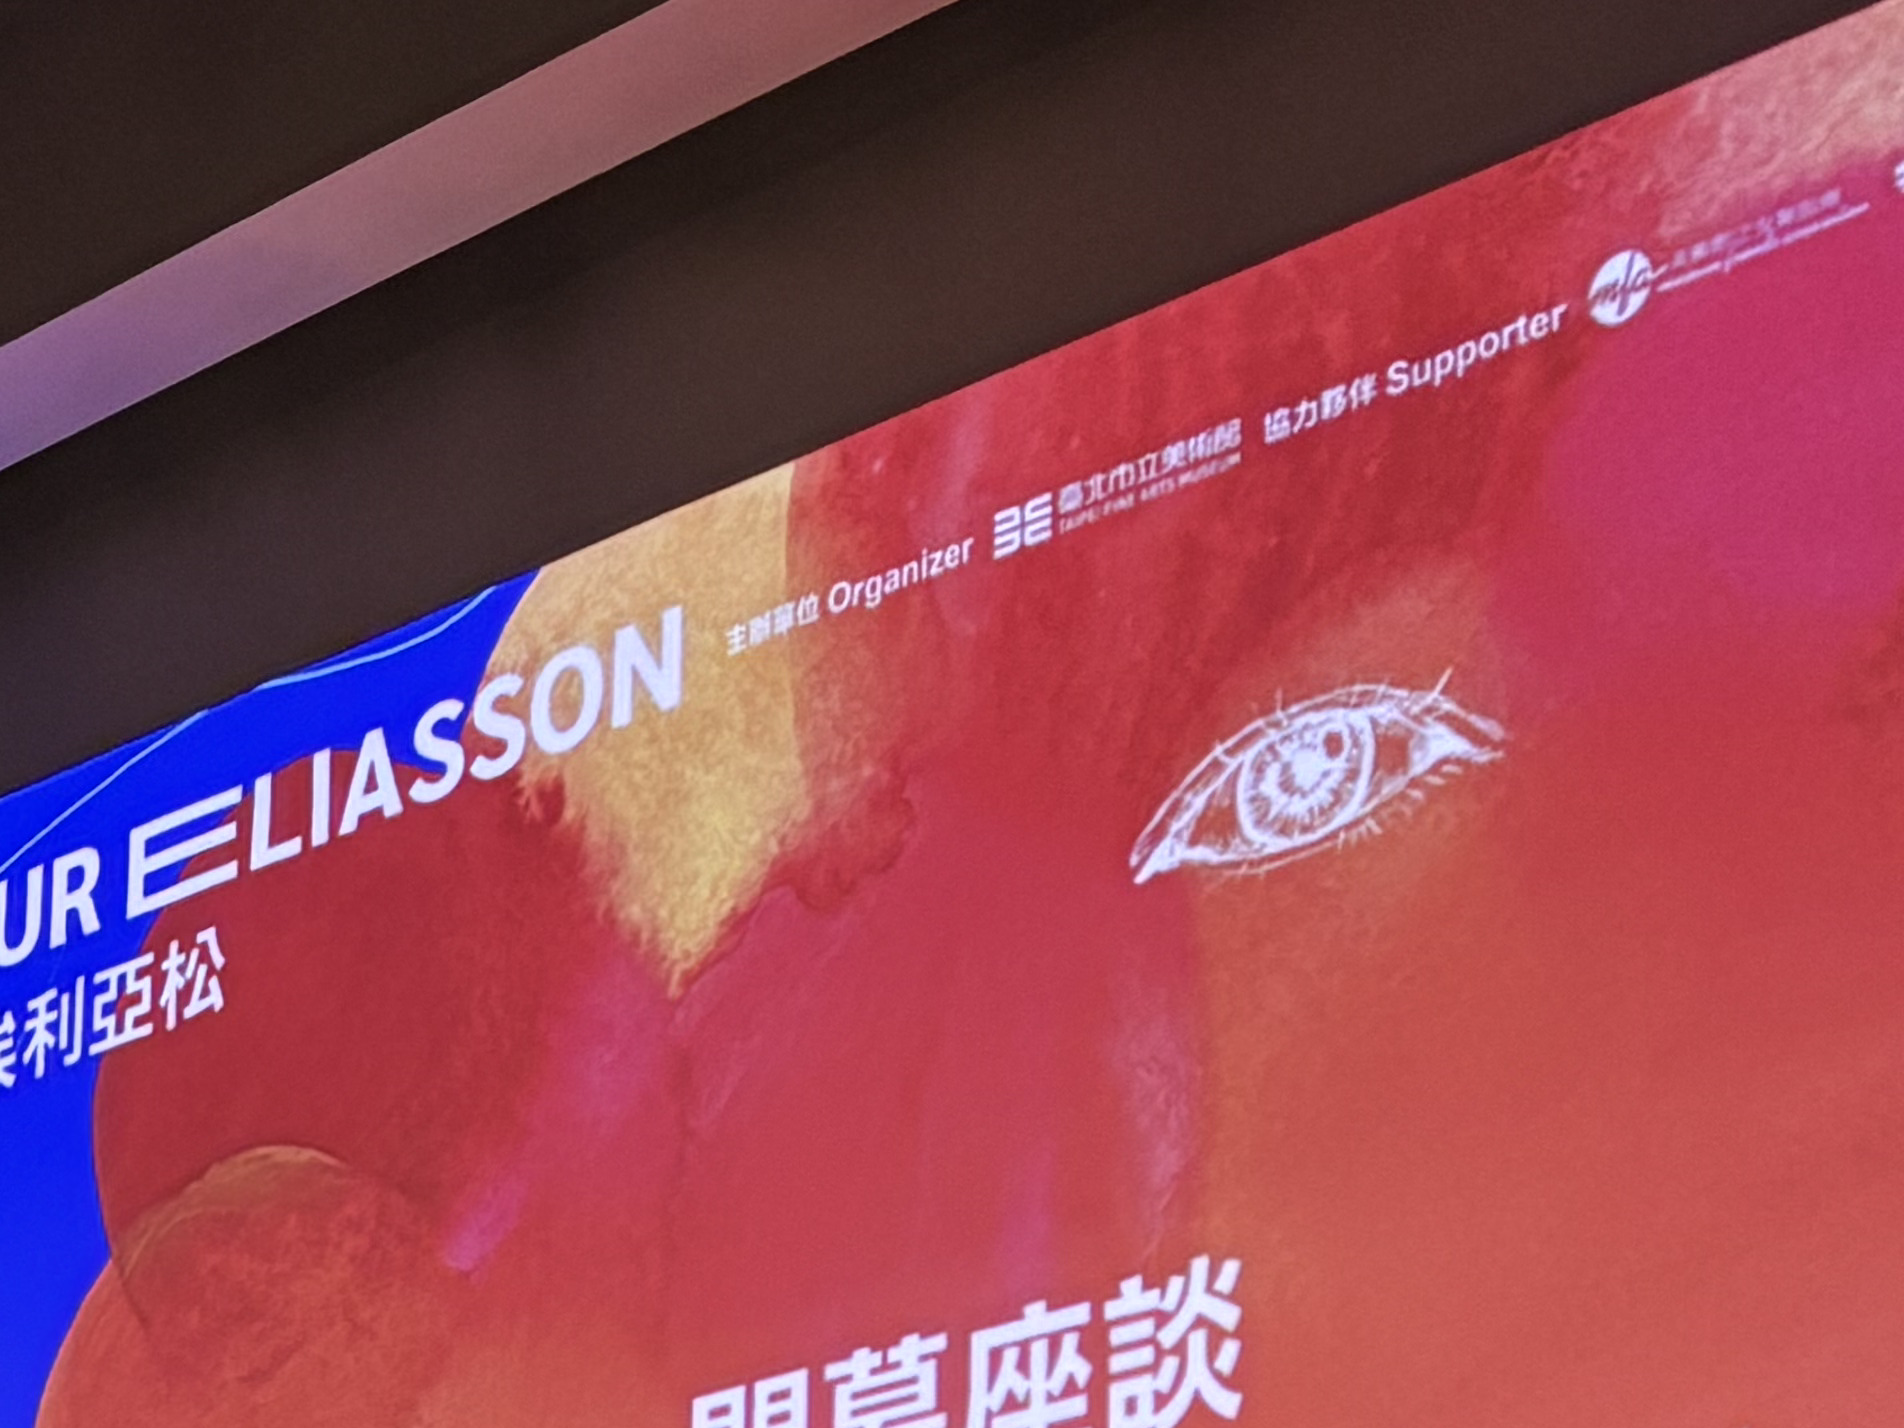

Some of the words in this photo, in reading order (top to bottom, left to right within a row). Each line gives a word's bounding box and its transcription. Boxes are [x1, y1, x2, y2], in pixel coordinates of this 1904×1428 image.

[1264, 373, 1378, 444] 協力夥伴
[1386, 302, 1569, 396] Supporter
[725, 592, 820, 657] 主辦單位
[827, 536, 975, 615] Organizer
[125, 605, 685, 919] ELIASSON
